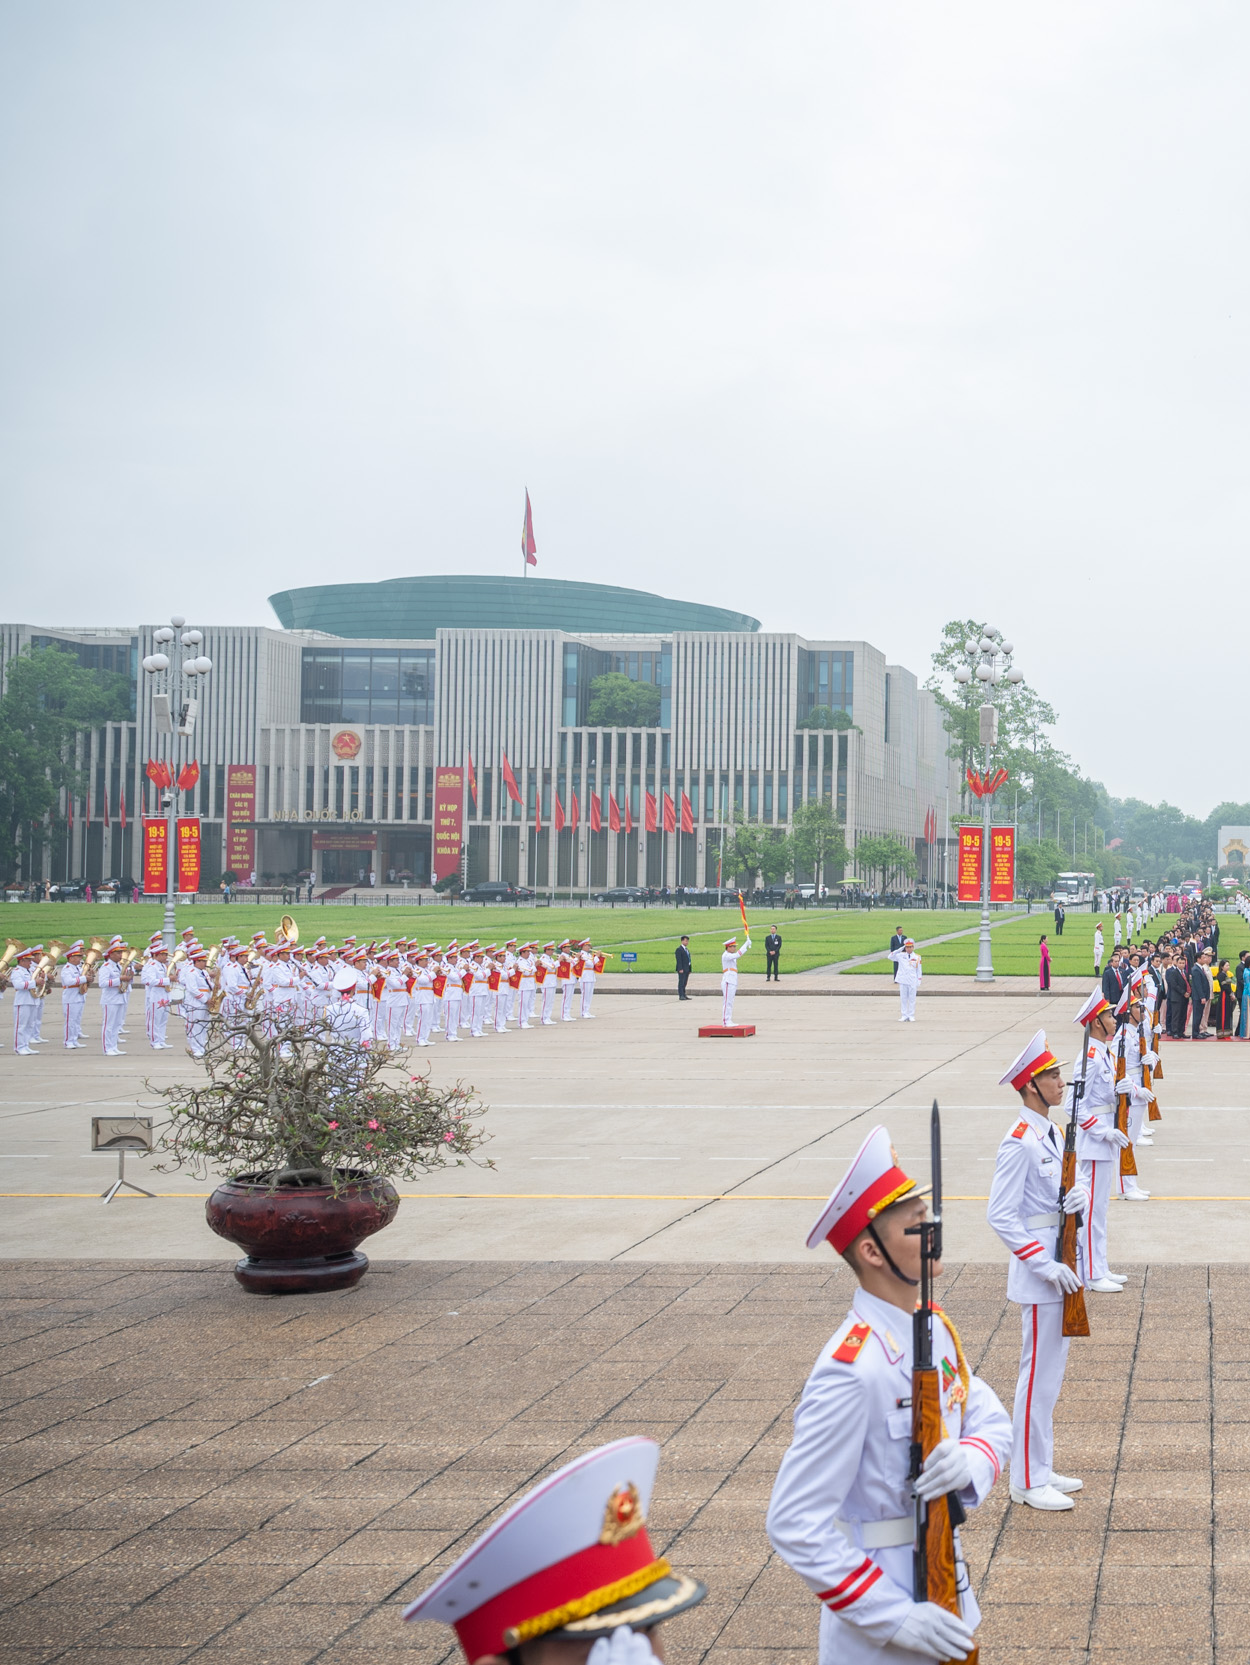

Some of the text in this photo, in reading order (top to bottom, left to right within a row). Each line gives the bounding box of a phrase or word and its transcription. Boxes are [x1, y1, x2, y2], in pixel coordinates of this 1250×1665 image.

[273, 806, 364, 822] NHÀ QUỐC HỘI
[148, 826, 165, 838] 19-5
[180, 826, 198, 838] 19-5
[962, 835, 980, 846] 19-5
[994, 835, 1011, 846] 19-5
